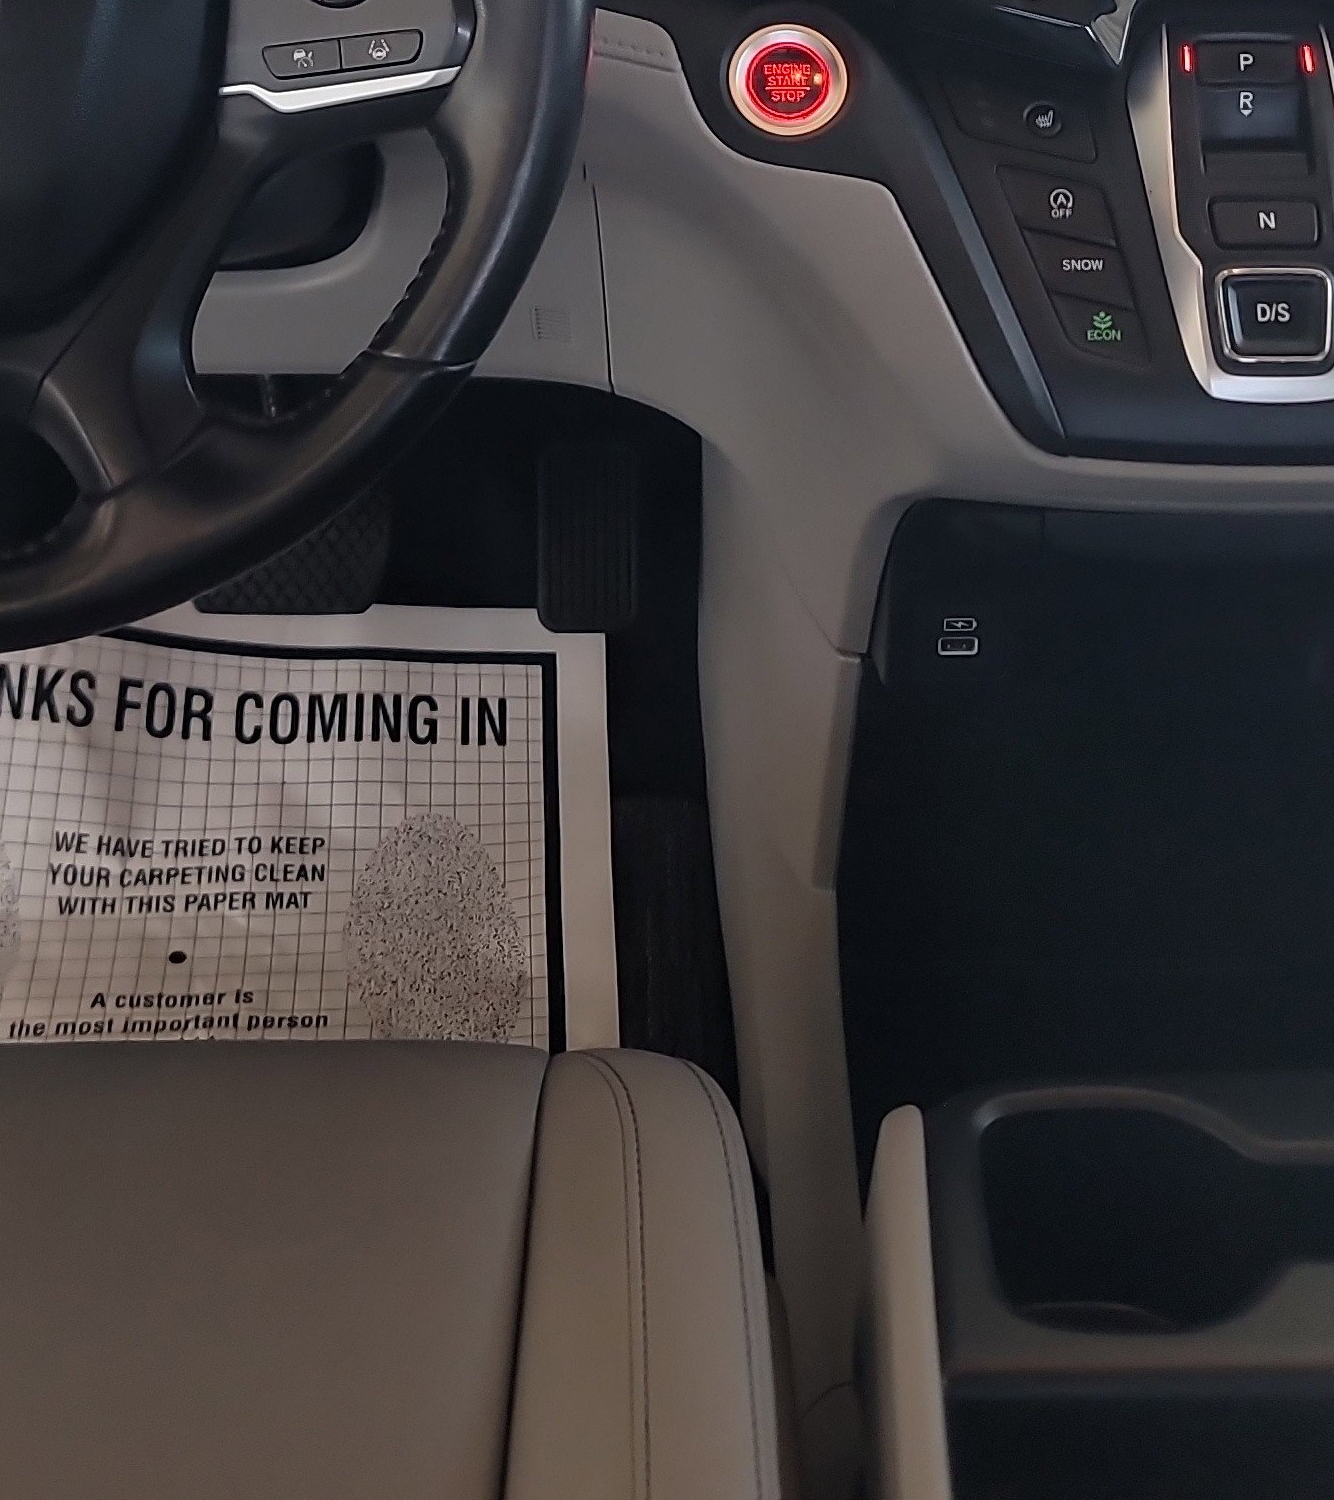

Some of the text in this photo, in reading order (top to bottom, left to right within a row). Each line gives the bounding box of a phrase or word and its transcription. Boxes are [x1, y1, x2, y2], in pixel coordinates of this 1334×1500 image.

[764, 63, 811, 75] ENGINE
[1238, 53, 1254, 71] P
[771, 90, 806, 102] STOP
[1238, 91, 1254, 108] R
[1051, 208, 1072, 219] OFF
[1258, 212, 1276, 230] N
[1062, 259, 1103, 271] SNOW
[1256, 303, 1290, 323] D/S
[1087, 329, 1121, 341] ECON
[114, 677, 214, 742] FOR
[234, 691, 439, 745] COMING
[460, 696, 507, 746] IN
[54, 830, 326, 859] WE HAVE TRIED TO KEEP
[49, 862, 326, 888] YOUR CARPETING CLEAN
[58, 891, 312, 916] WITH THIS PAPER MAT
[90, 988, 254, 1009] A customer is
[9, 1011, 329, 1039] the most important person
